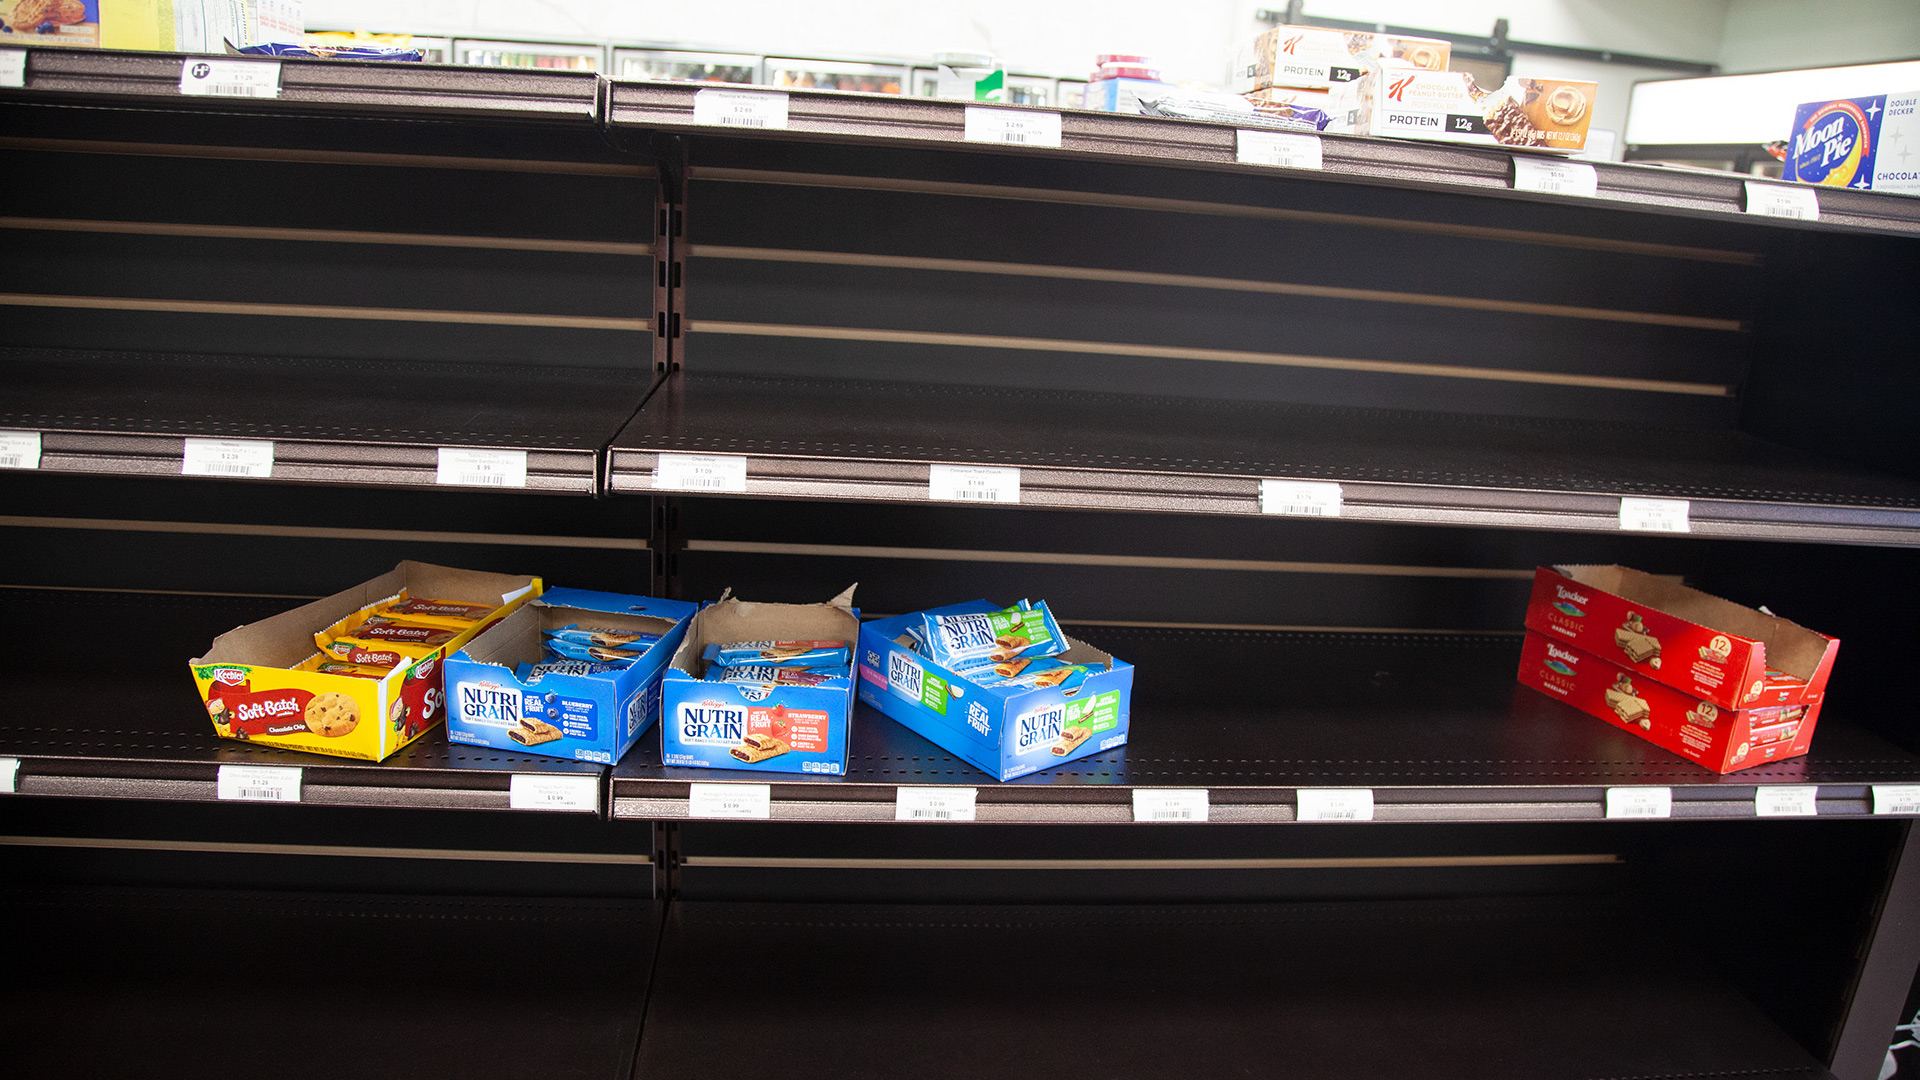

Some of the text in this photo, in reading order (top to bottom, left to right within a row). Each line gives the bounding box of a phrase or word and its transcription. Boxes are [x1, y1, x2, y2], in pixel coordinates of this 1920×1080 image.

[1283, 65, 1351, 81] PROTEIN 12g
[1408, 89, 1465, 100] PEANUT BUTTER
[1415, 83, 1458, 92] CHOCOLATE
[1890, 98, 1918, 107] DOUBLE
[1888, 107, 1914, 116] DECKER
[1389, 114, 1473, 132] PROTEIN 12g
[1792, 116, 1845, 160] Moon
[1820, 134, 1852, 168] Pie
[1556, 585, 1589, 605] Loacker
[945, 617, 1010, 637] NUTRI REAL
[1548, 612, 1584, 633] CLASSIC
[370, 627, 430, 638] Soft Batch
[1551, 625, 1577, 638] HAZELNUT
[951, 632, 996, 650] GRAIN
[355, 653, 393, 663] Soft Batch
[1547, 643, 1579, 665] Loacker
[215, 668, 245, 683] Keebler
[891, 656, 921, 680] NUTRI
[479, 680, 500, 690] Kellogg's
[890, 670, 920, 694] GRAIN
[1539, 670, 1576, 691] CLASSIC
[1543, 681, 1568, 696] HAZELNUT
[463, 687, 518, 707] NUTRI
[524, 698, 544, 707] REAL
[562, 700, 594, 710] BLUEBERRY
[238, 698, 300, 722] Soft Batch
[463, 703, 518, 722] GRAIN
[525, 705, 544, 714] FRUIT
[684, 708, 743, 725] NUTRI
[750, 714, 770, 722] REAL
[968, 703, 991, 728] REAL
[268, 723, 306, 735] Chocolate Chip
[750, 720, 772, 729] FRUIT
[967, 714, 991, 737] FRUIT
[1020, 709, 1062, 736] NUTRI
[684, 723, 742, 740] GRAIN
[1019, 722, 1061, 747] GRAIN
